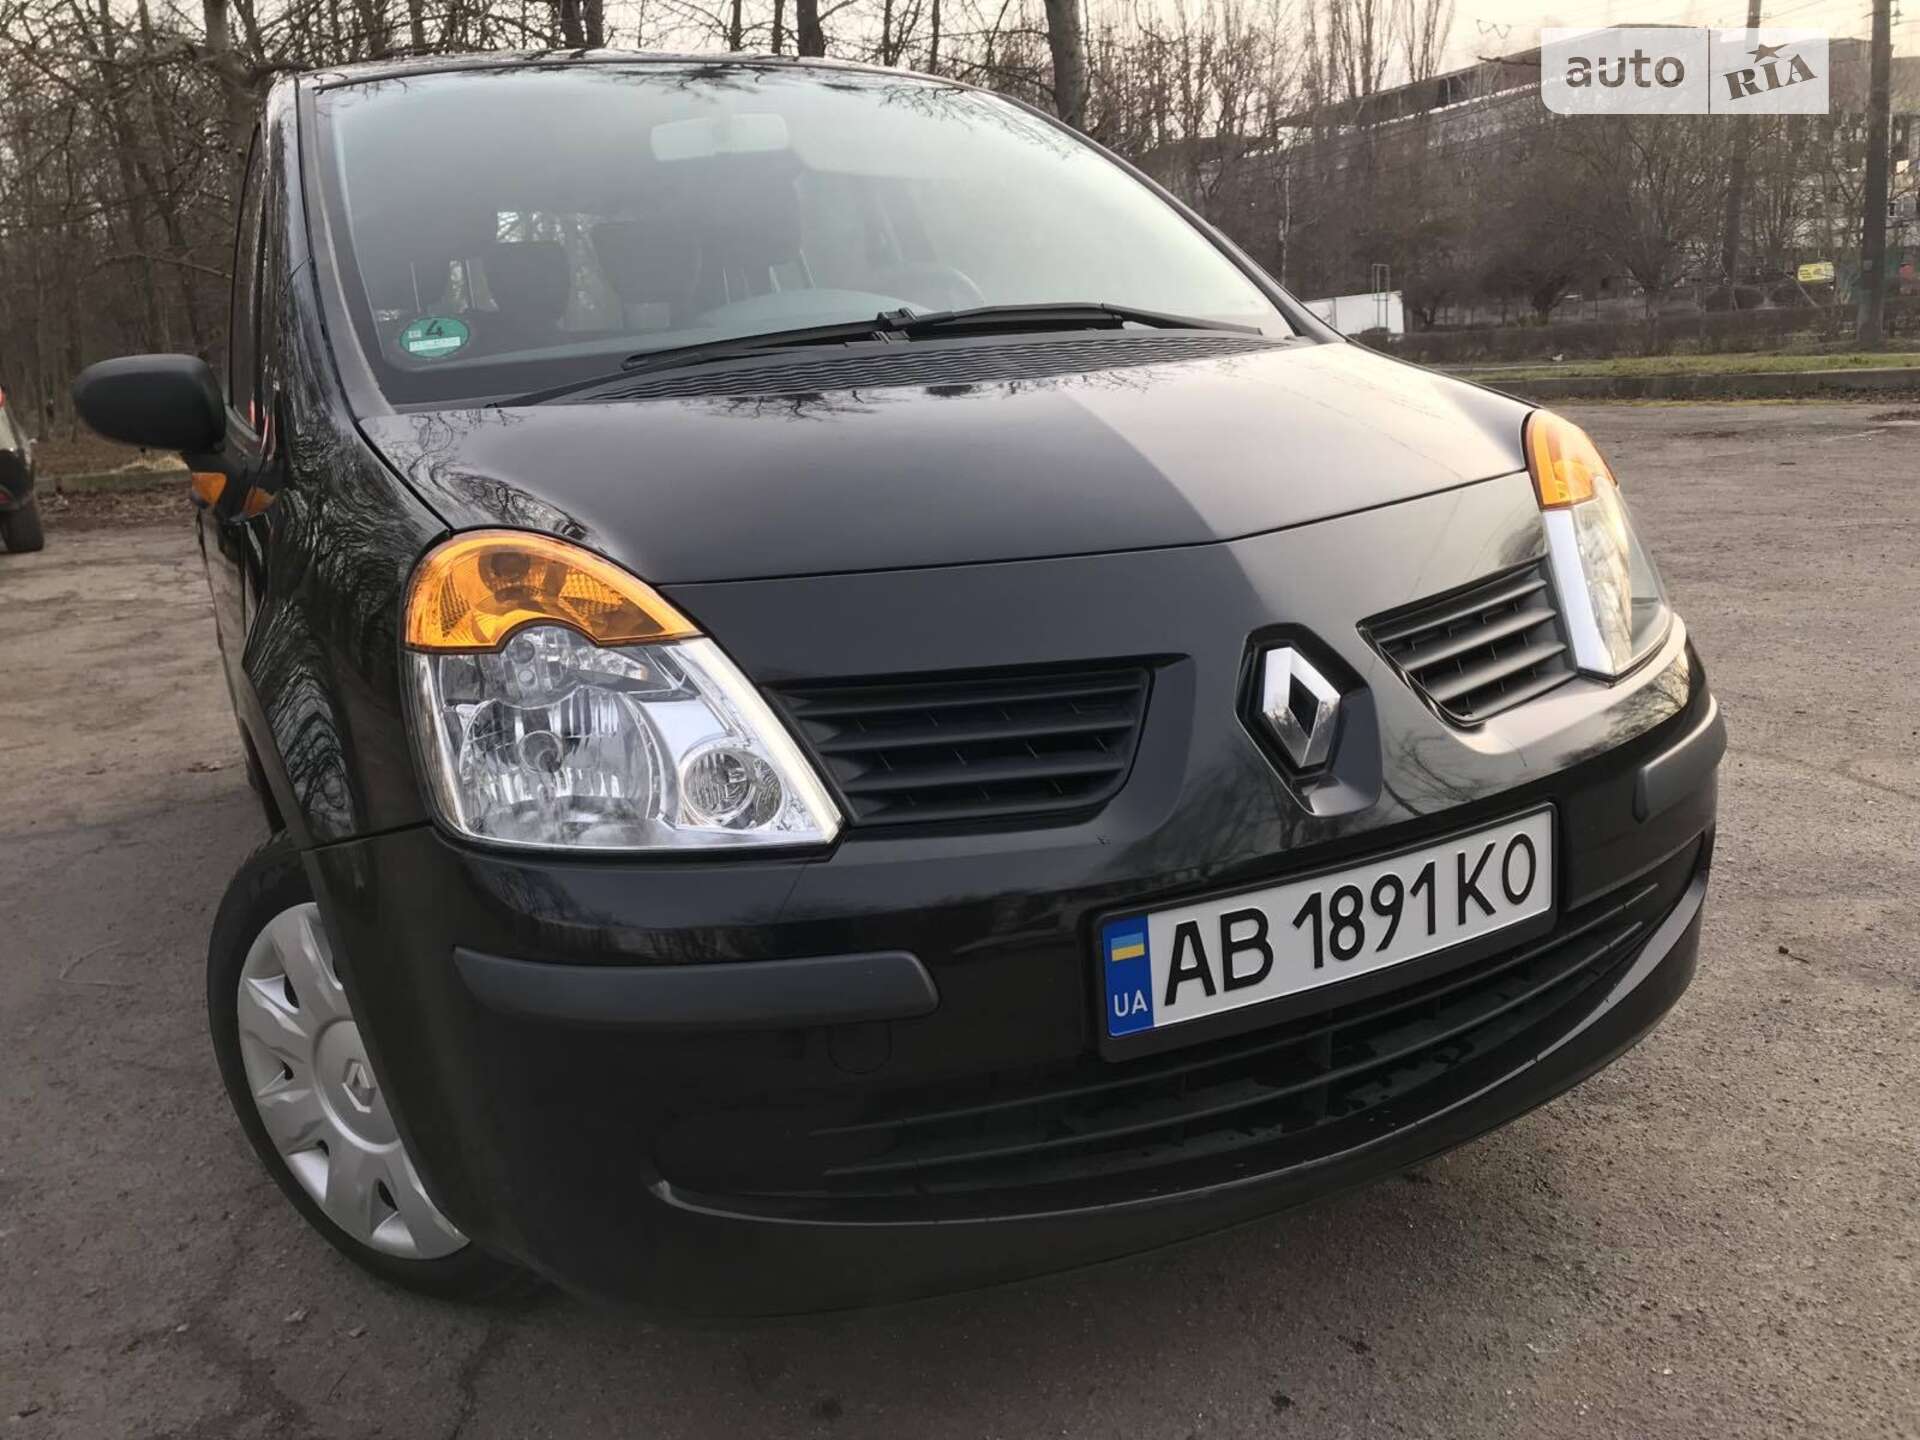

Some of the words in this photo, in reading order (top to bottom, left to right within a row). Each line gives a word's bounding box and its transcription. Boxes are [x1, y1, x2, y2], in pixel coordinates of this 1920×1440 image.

[425, 320, 444, 336] 4
[1164, 908, 1274, 1006] AB
[1292, 861, 1436, 969] 1891
[1457, 832, 1537, 926] KO
[1113, 989, 1149, 1017] UA
